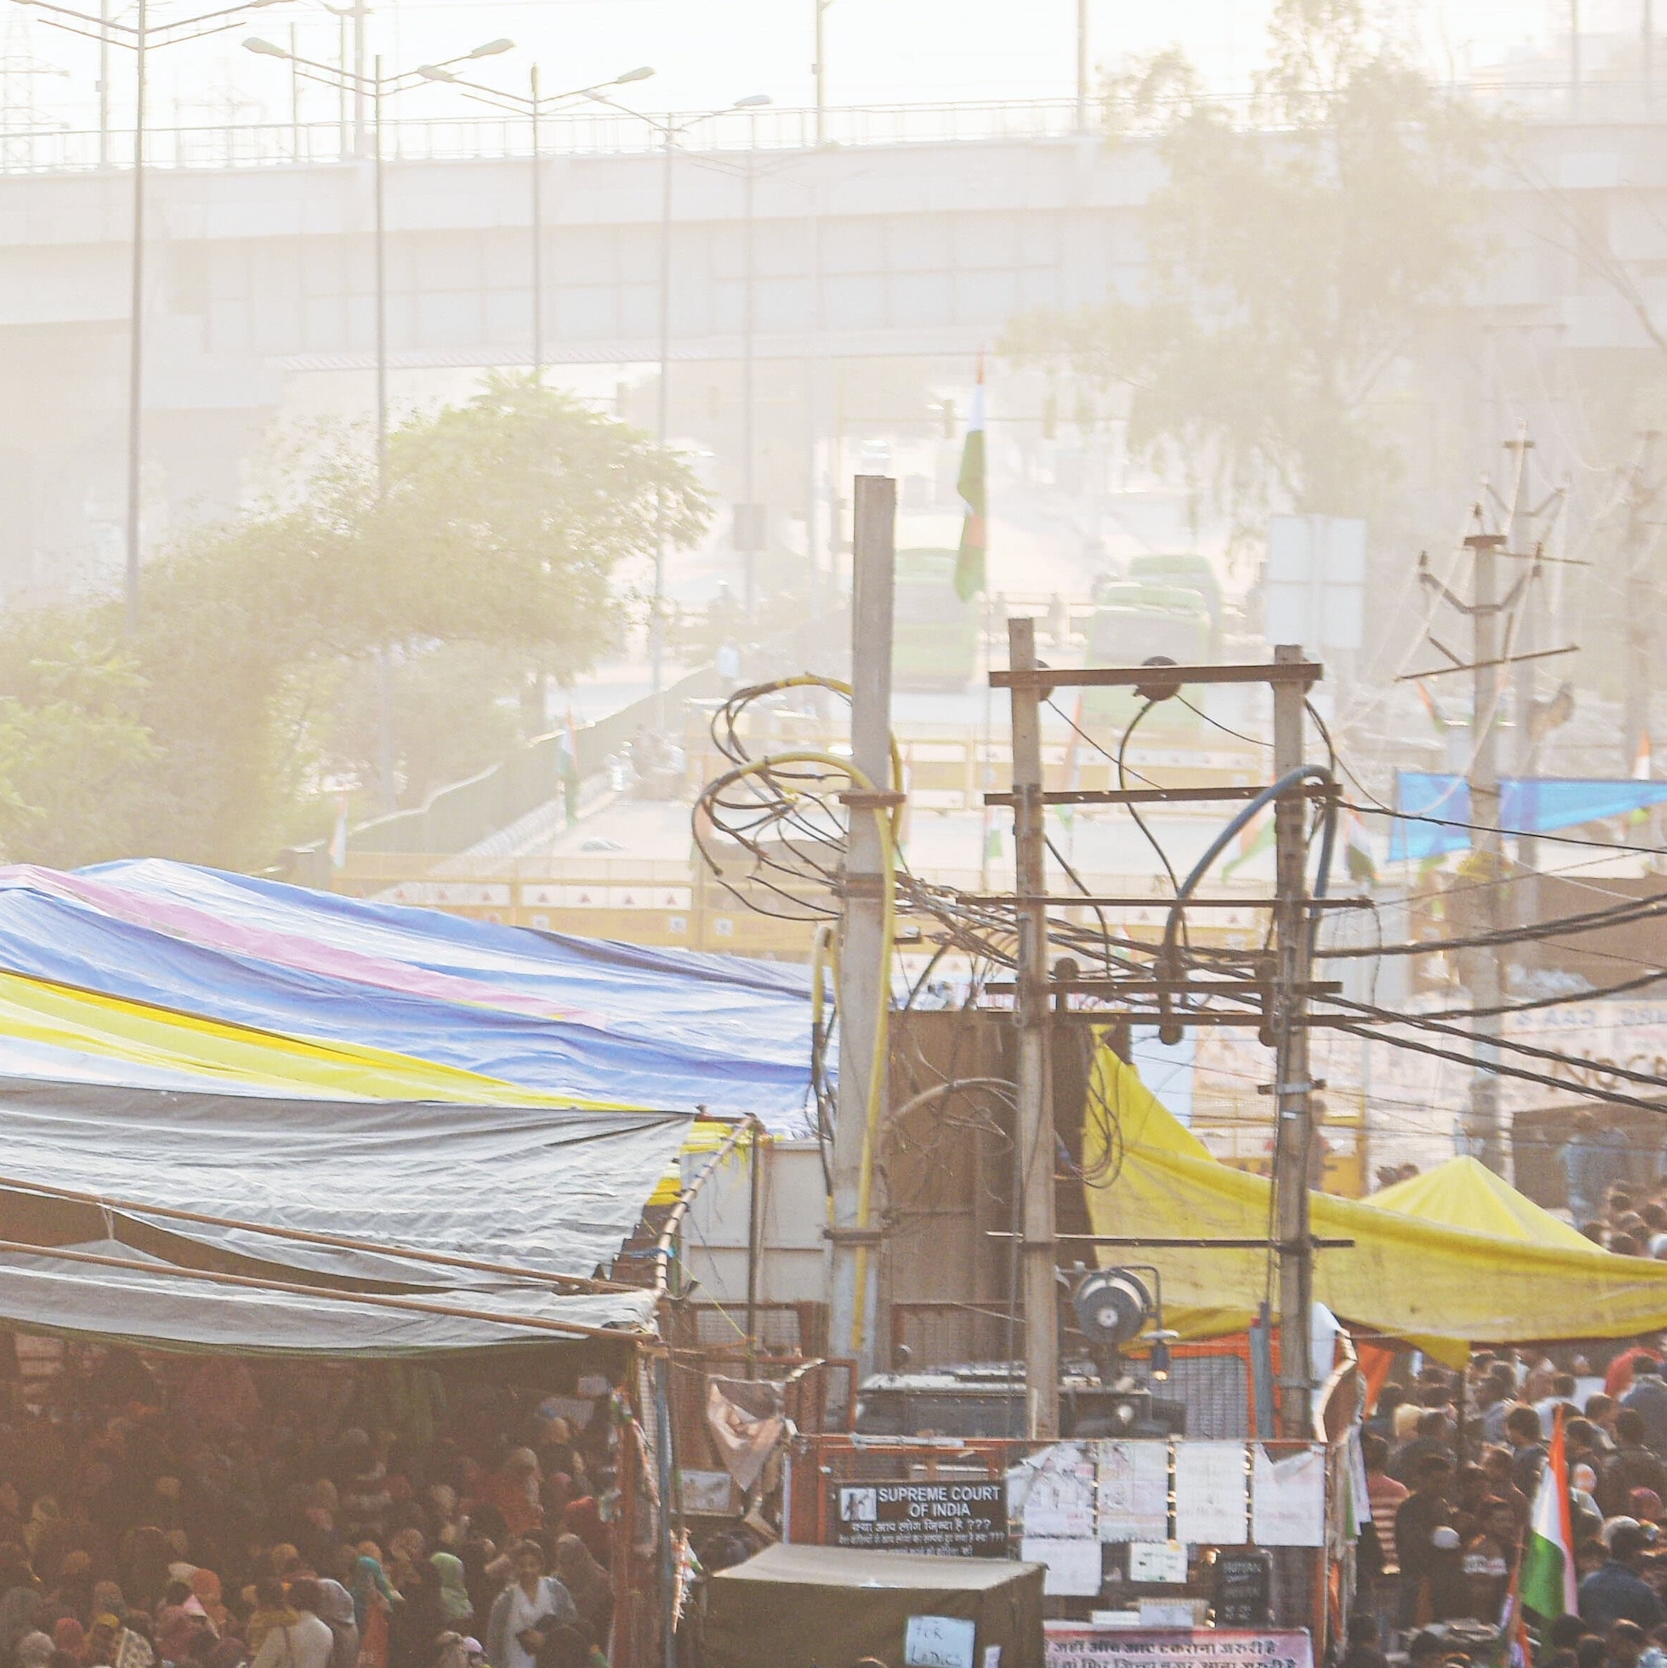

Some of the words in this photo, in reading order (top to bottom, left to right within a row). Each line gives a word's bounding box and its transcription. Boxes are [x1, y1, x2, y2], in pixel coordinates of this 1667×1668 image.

[879, 1487, 948, 1502] SUPREME
[951, 1486, 1001, 1501] COURT
[908, 1502, 930, 1518] OF
[932, 1502, 971, 1517] INDIA
